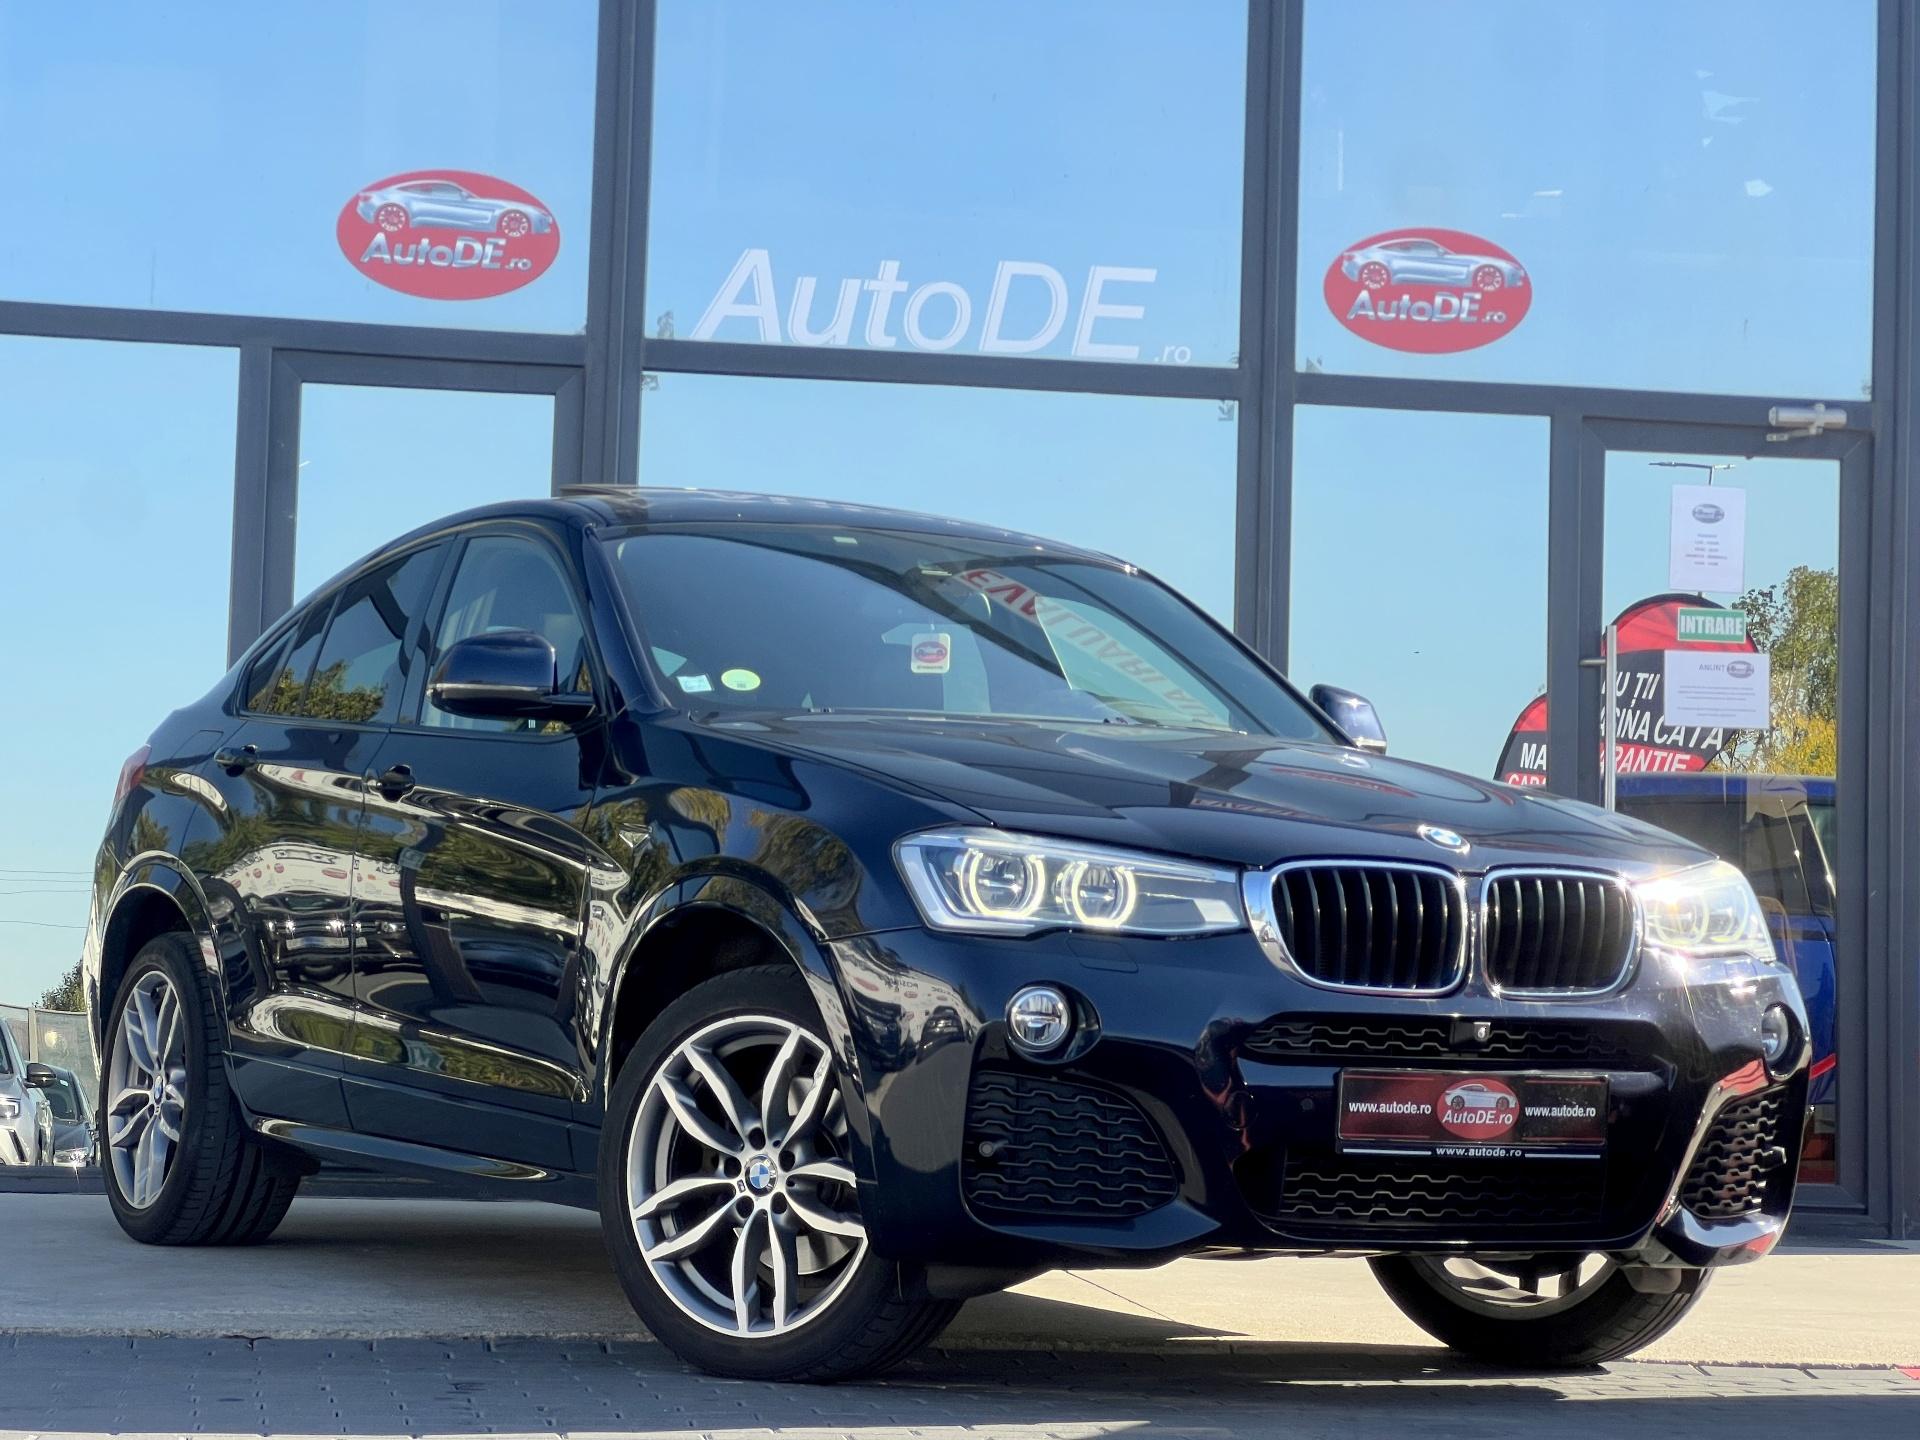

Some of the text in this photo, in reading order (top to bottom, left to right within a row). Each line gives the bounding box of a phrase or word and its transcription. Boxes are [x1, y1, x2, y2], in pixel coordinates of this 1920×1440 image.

[1680, 615, 1743, 635] INTRARE
[1349, 1101, 1432, 1115] www.autode.ro
[1525, 1105, 1596, 1118] www.autode.ro
[1442, 1109, 1513, 1126] AutoDE.ro
[1436, 1147, 1522, 1158] www.autode.ro
